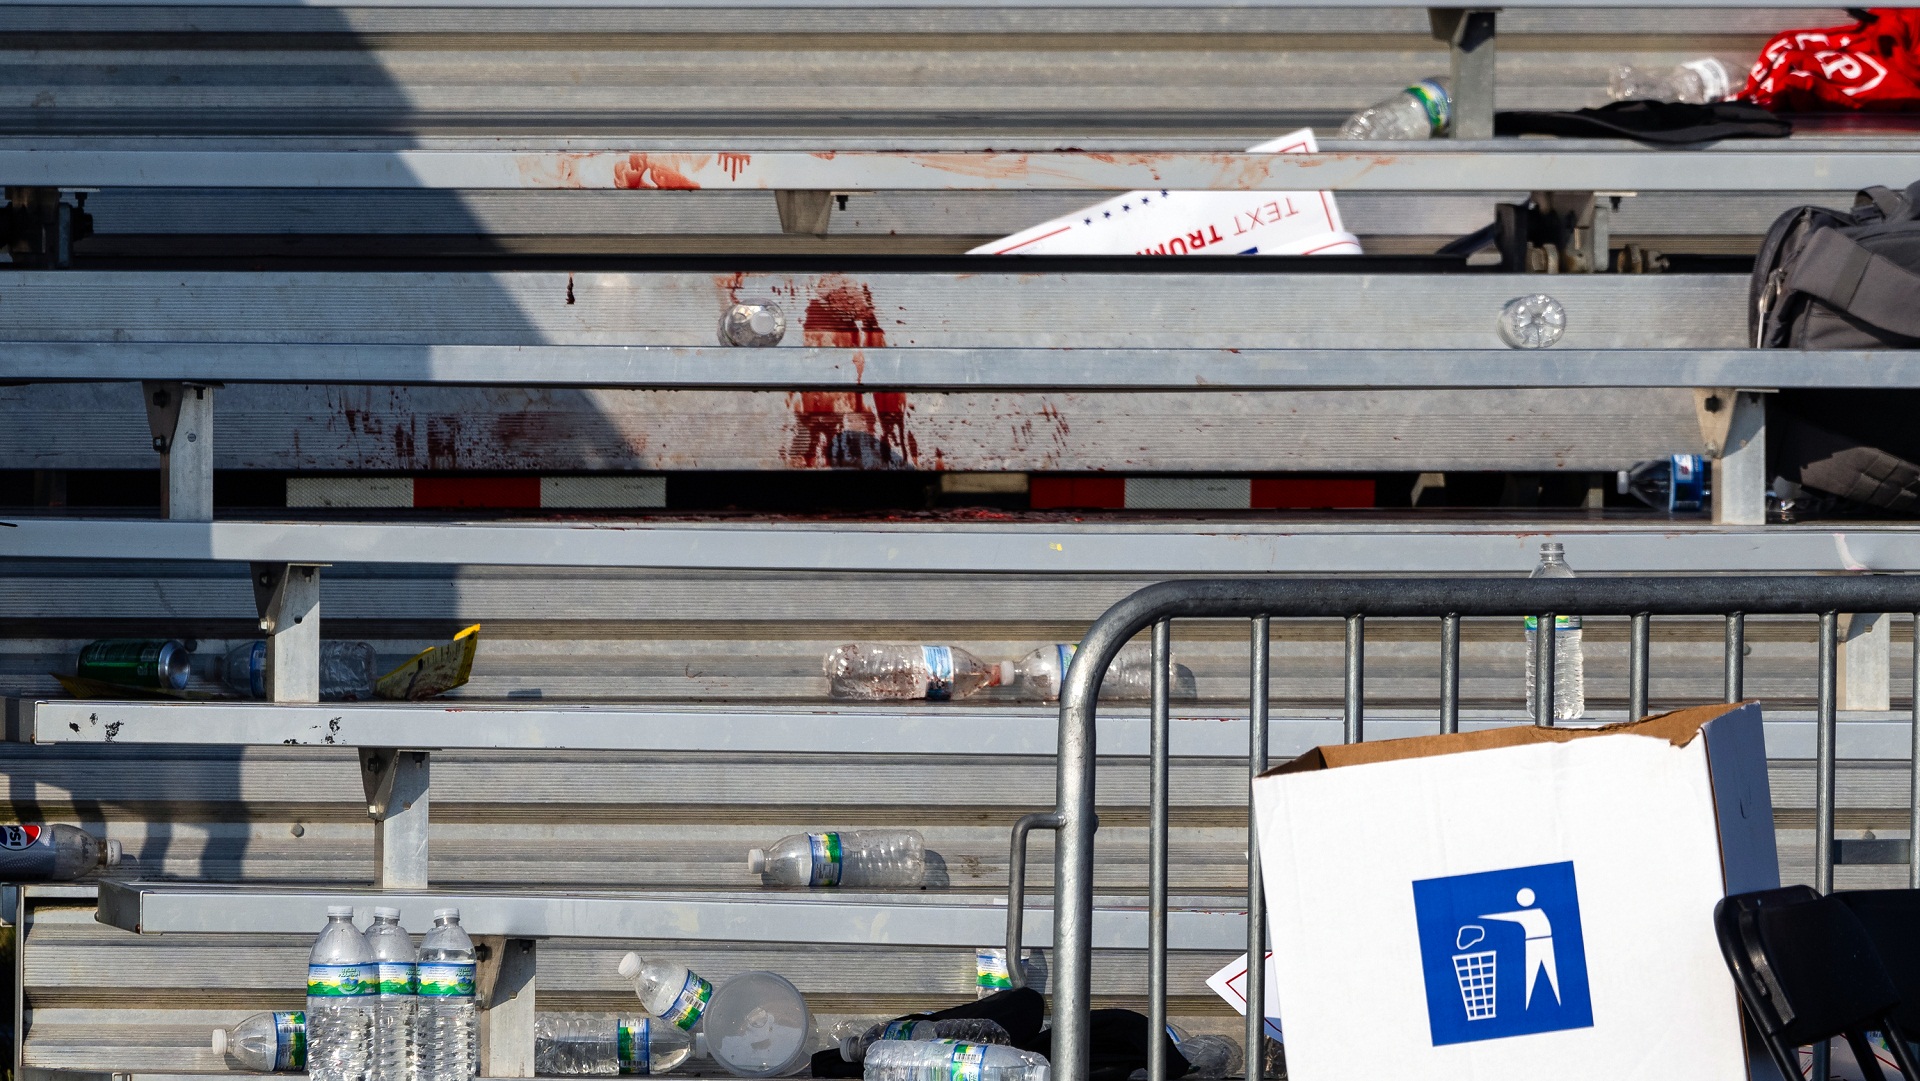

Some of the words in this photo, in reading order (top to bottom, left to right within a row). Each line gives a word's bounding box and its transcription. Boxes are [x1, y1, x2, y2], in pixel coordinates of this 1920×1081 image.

[1233, 197, 1299, 236] TEXT
[1136, 224, 1224, 255] TRUM
[8, 825, 21, 846] PSI
